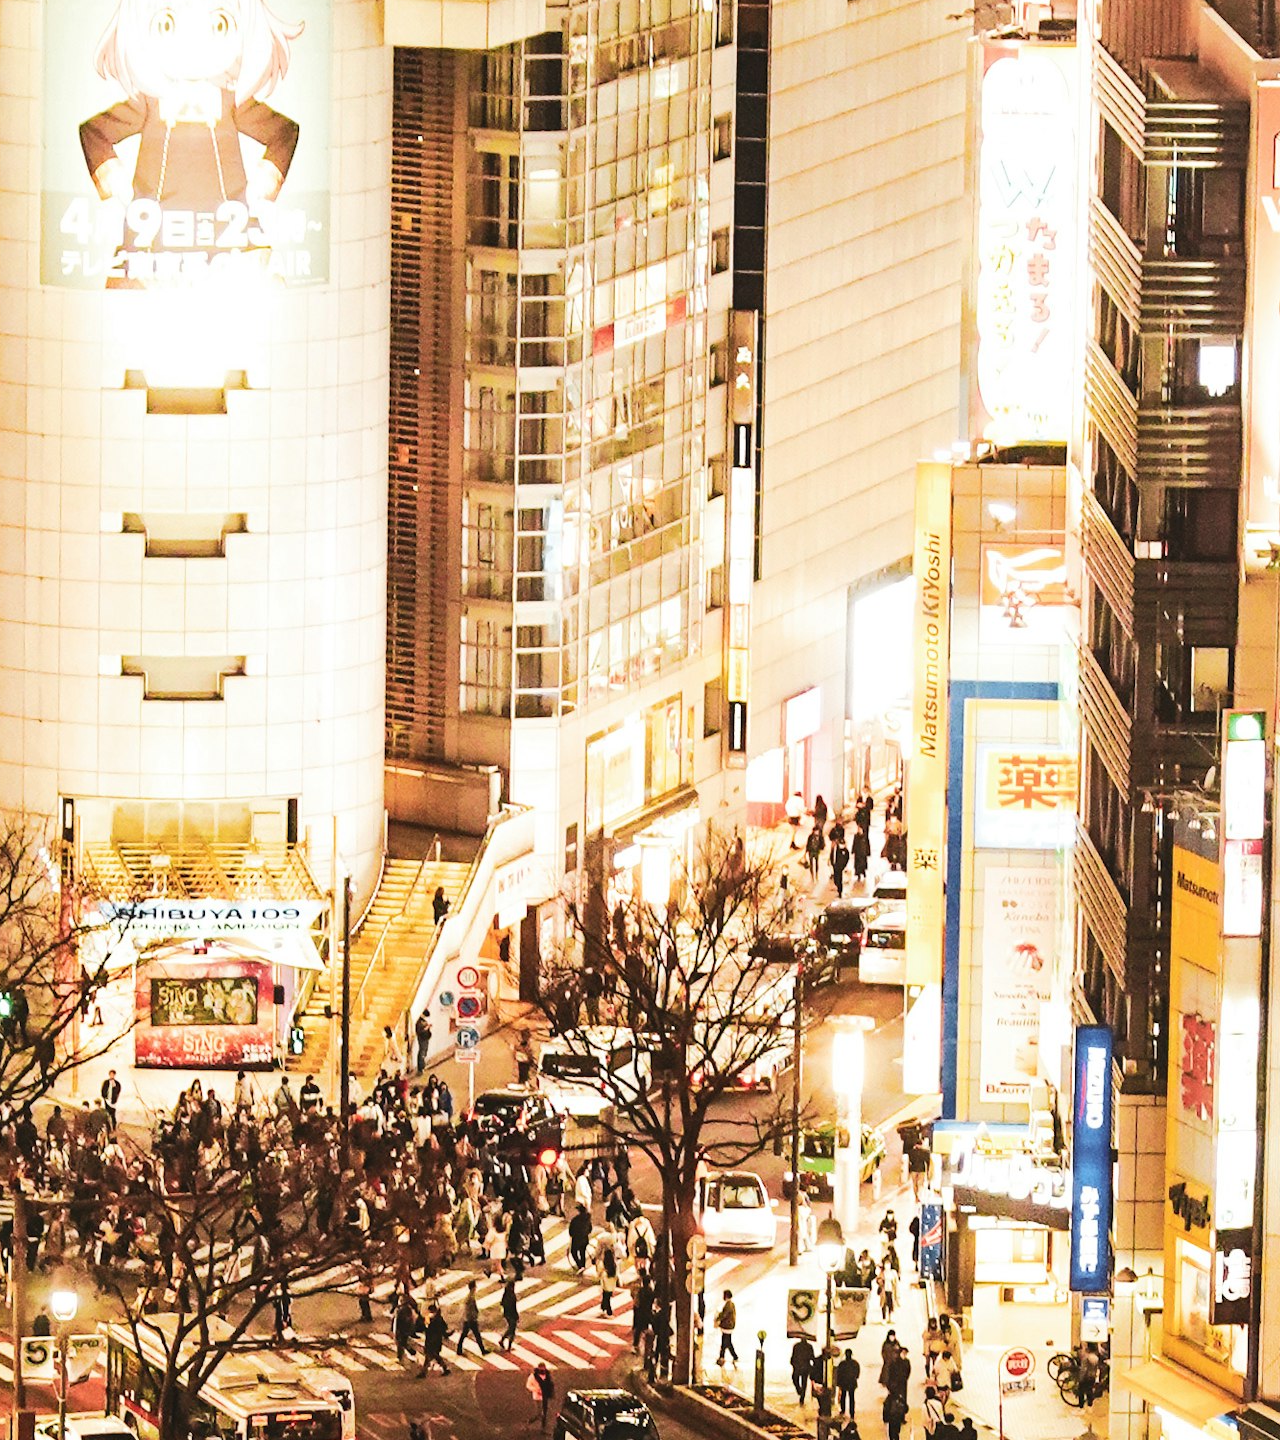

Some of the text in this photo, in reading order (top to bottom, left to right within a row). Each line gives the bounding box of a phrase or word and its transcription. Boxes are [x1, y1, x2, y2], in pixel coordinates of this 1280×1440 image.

[920, 623, 942, 759] Matsumoto
[998, 754, 1065, 809] 薬
[246, 907, 301, 921] 109
[182, 1030, 226, 1055] SING
